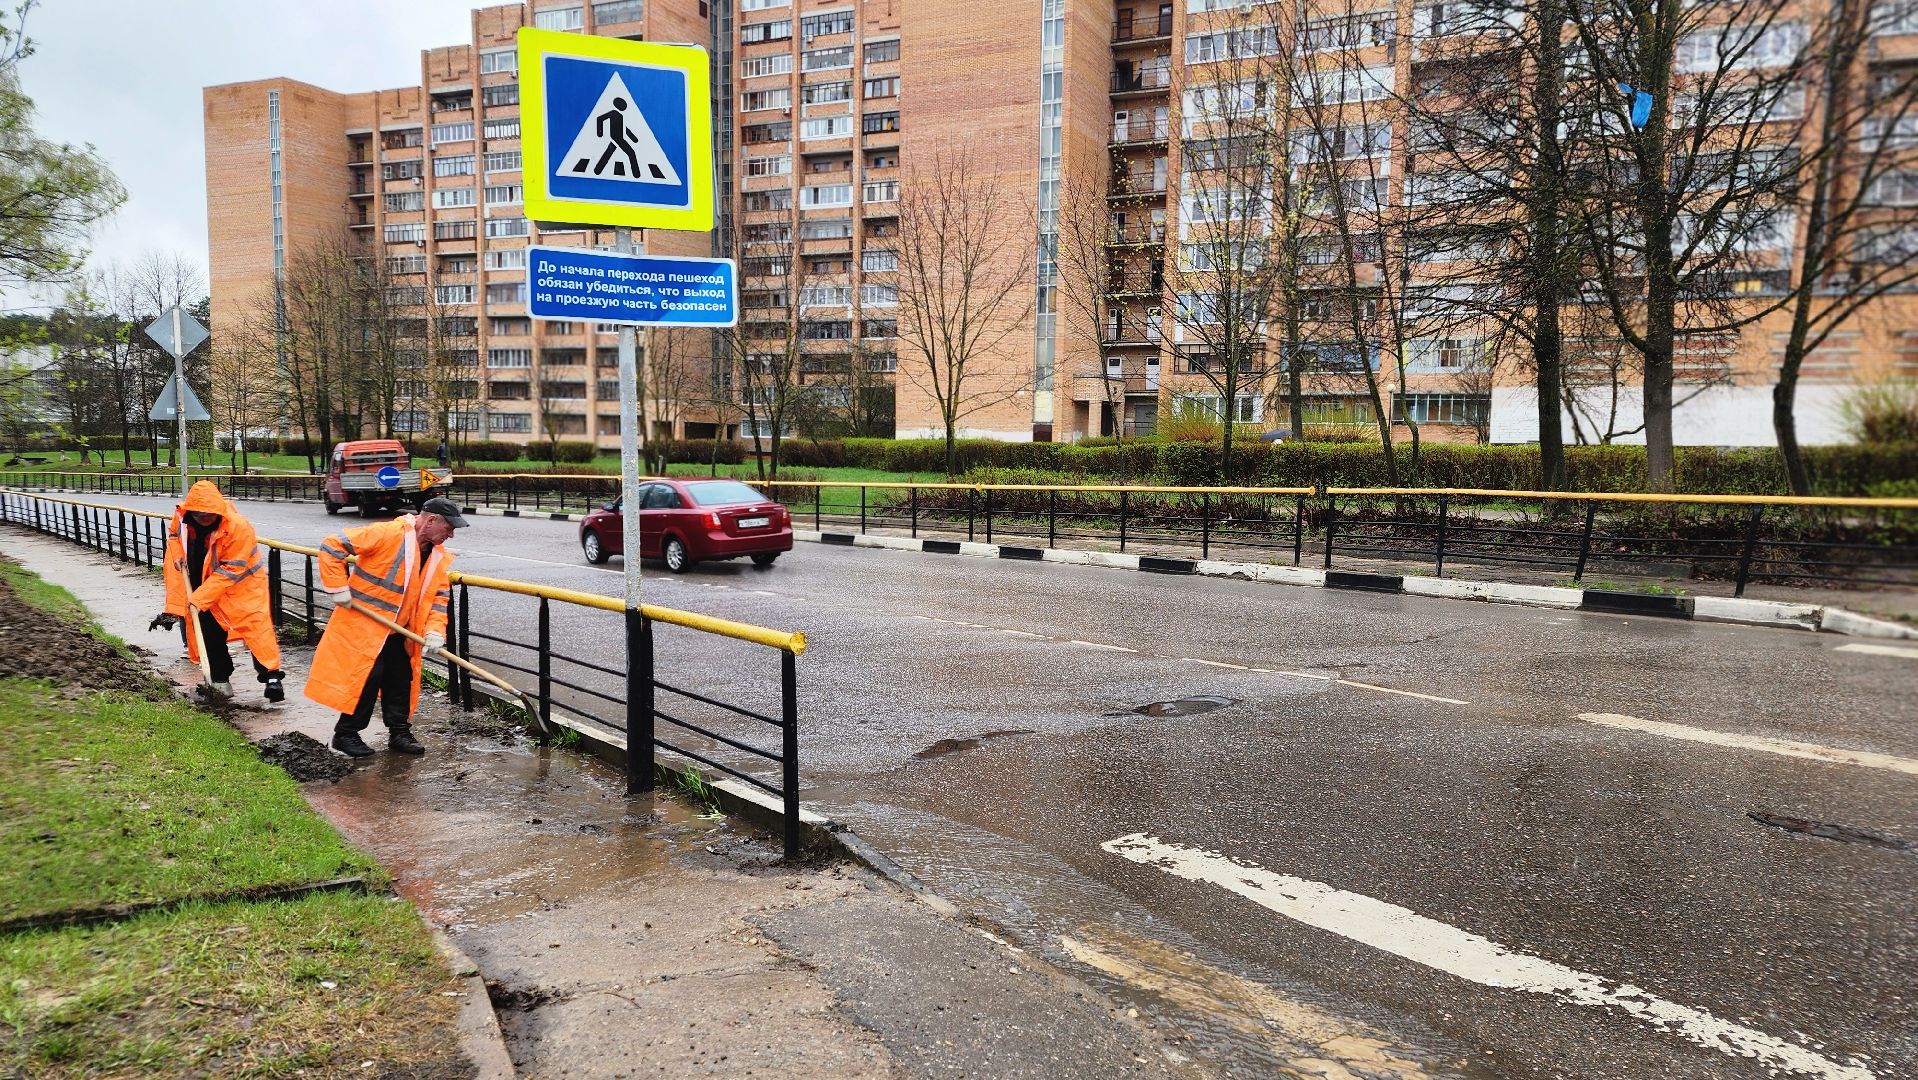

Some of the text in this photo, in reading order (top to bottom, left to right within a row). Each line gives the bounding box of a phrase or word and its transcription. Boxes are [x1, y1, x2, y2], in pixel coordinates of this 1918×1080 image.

[537, 260, 725, 285] До начала перехода пешеход
[537, 277, 725, 299] обязан убедиться, что выход
[536, 292, 727, 311] на проезжую часть безопасен
